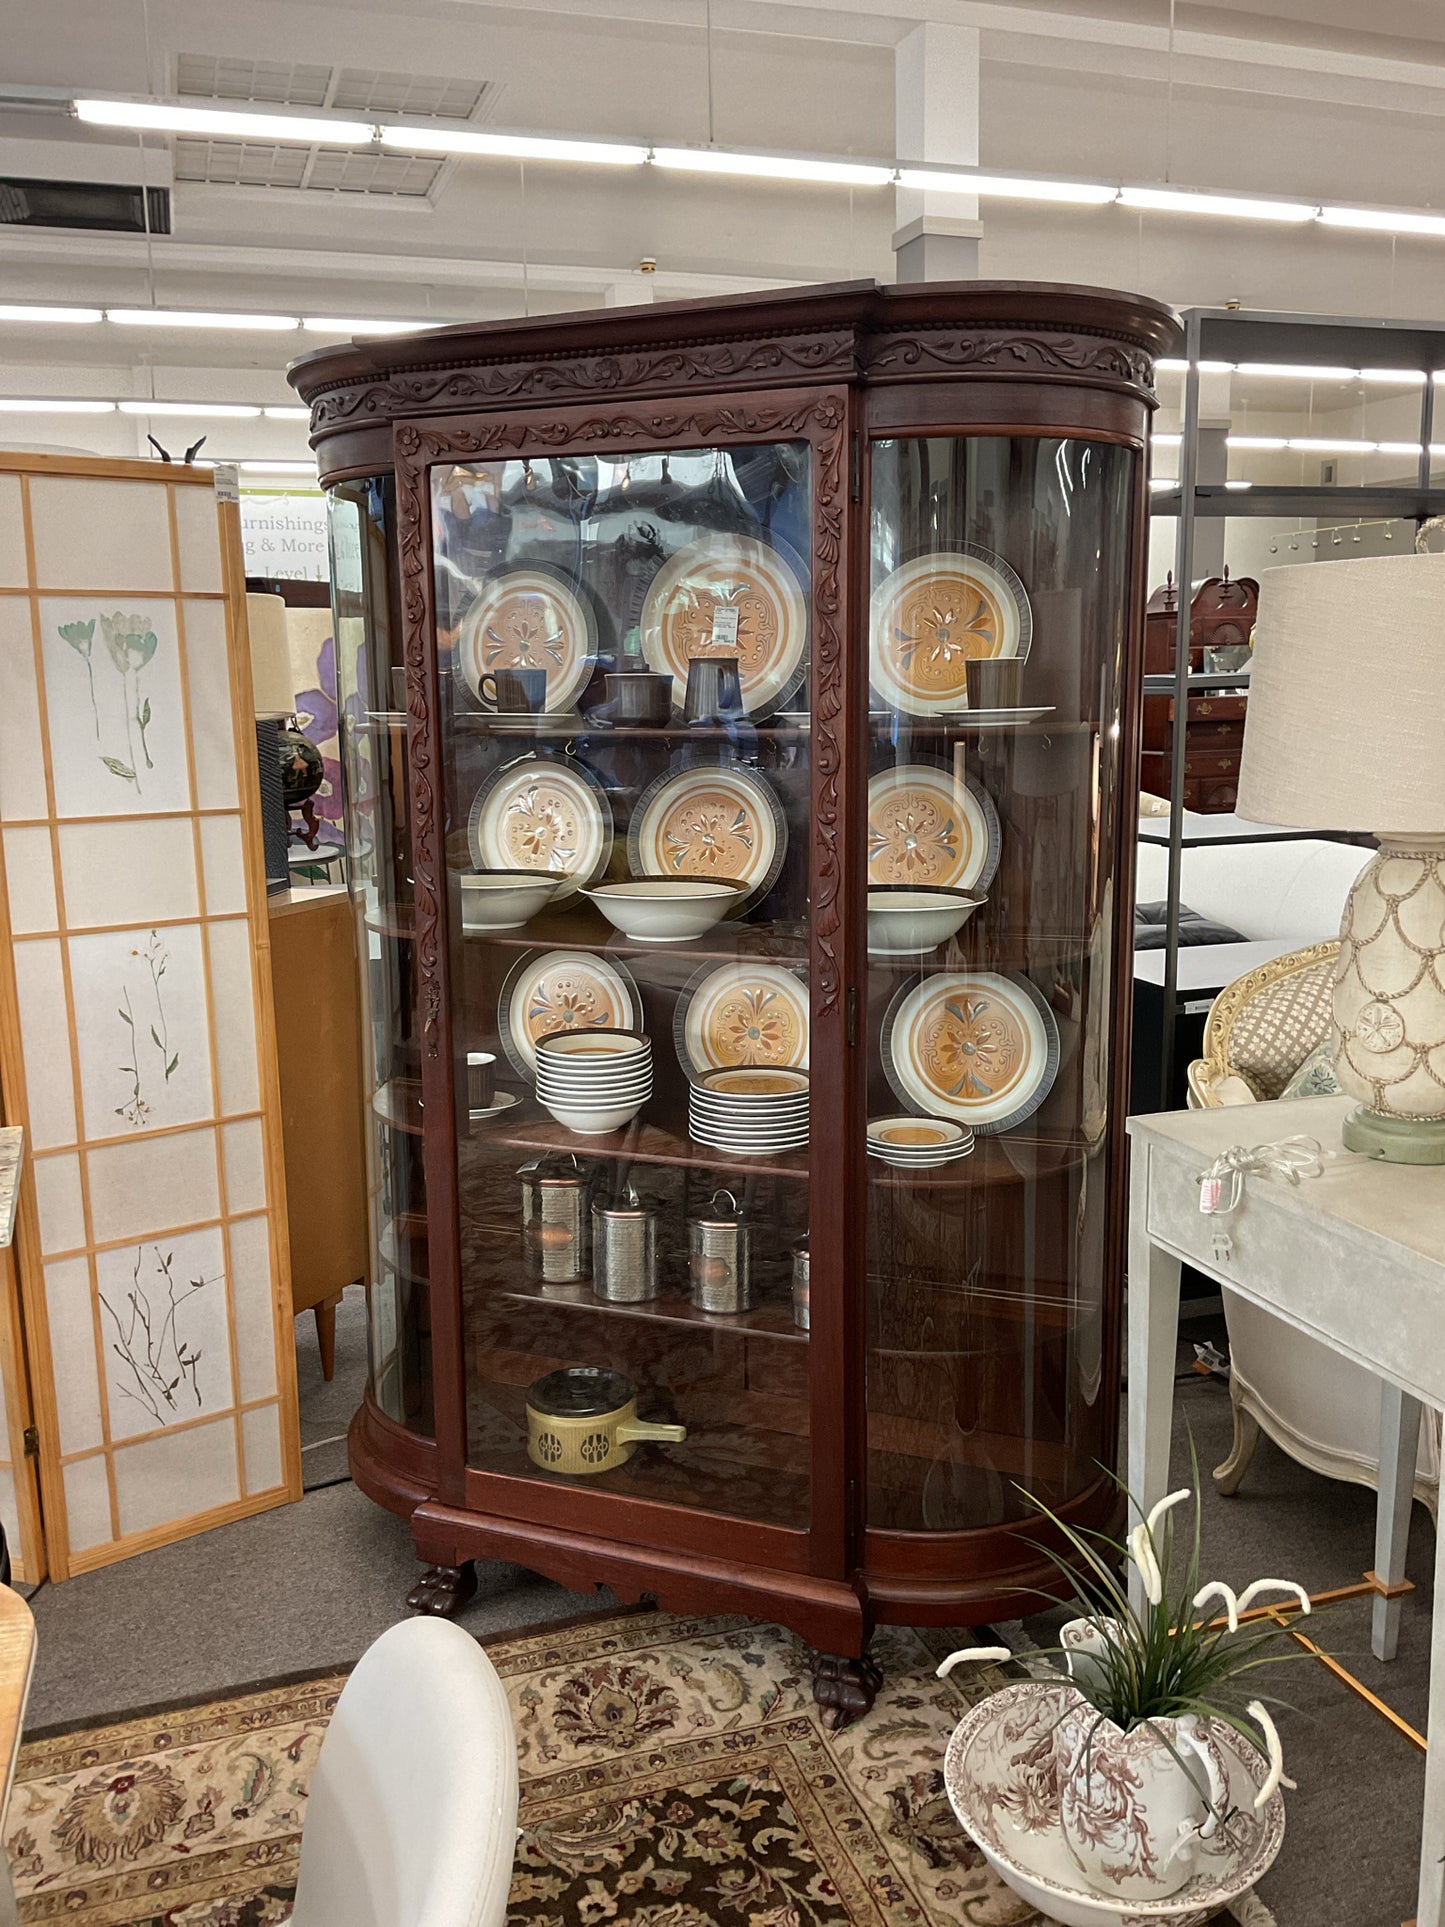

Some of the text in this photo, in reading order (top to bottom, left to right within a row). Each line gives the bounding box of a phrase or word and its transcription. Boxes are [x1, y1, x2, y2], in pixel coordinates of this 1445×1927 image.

[241, 516, 328, 534] urnishings
[261, 538, 276, 553] &
[281, 538, 324, 553] More
[265, 566, 308, 579] Level
